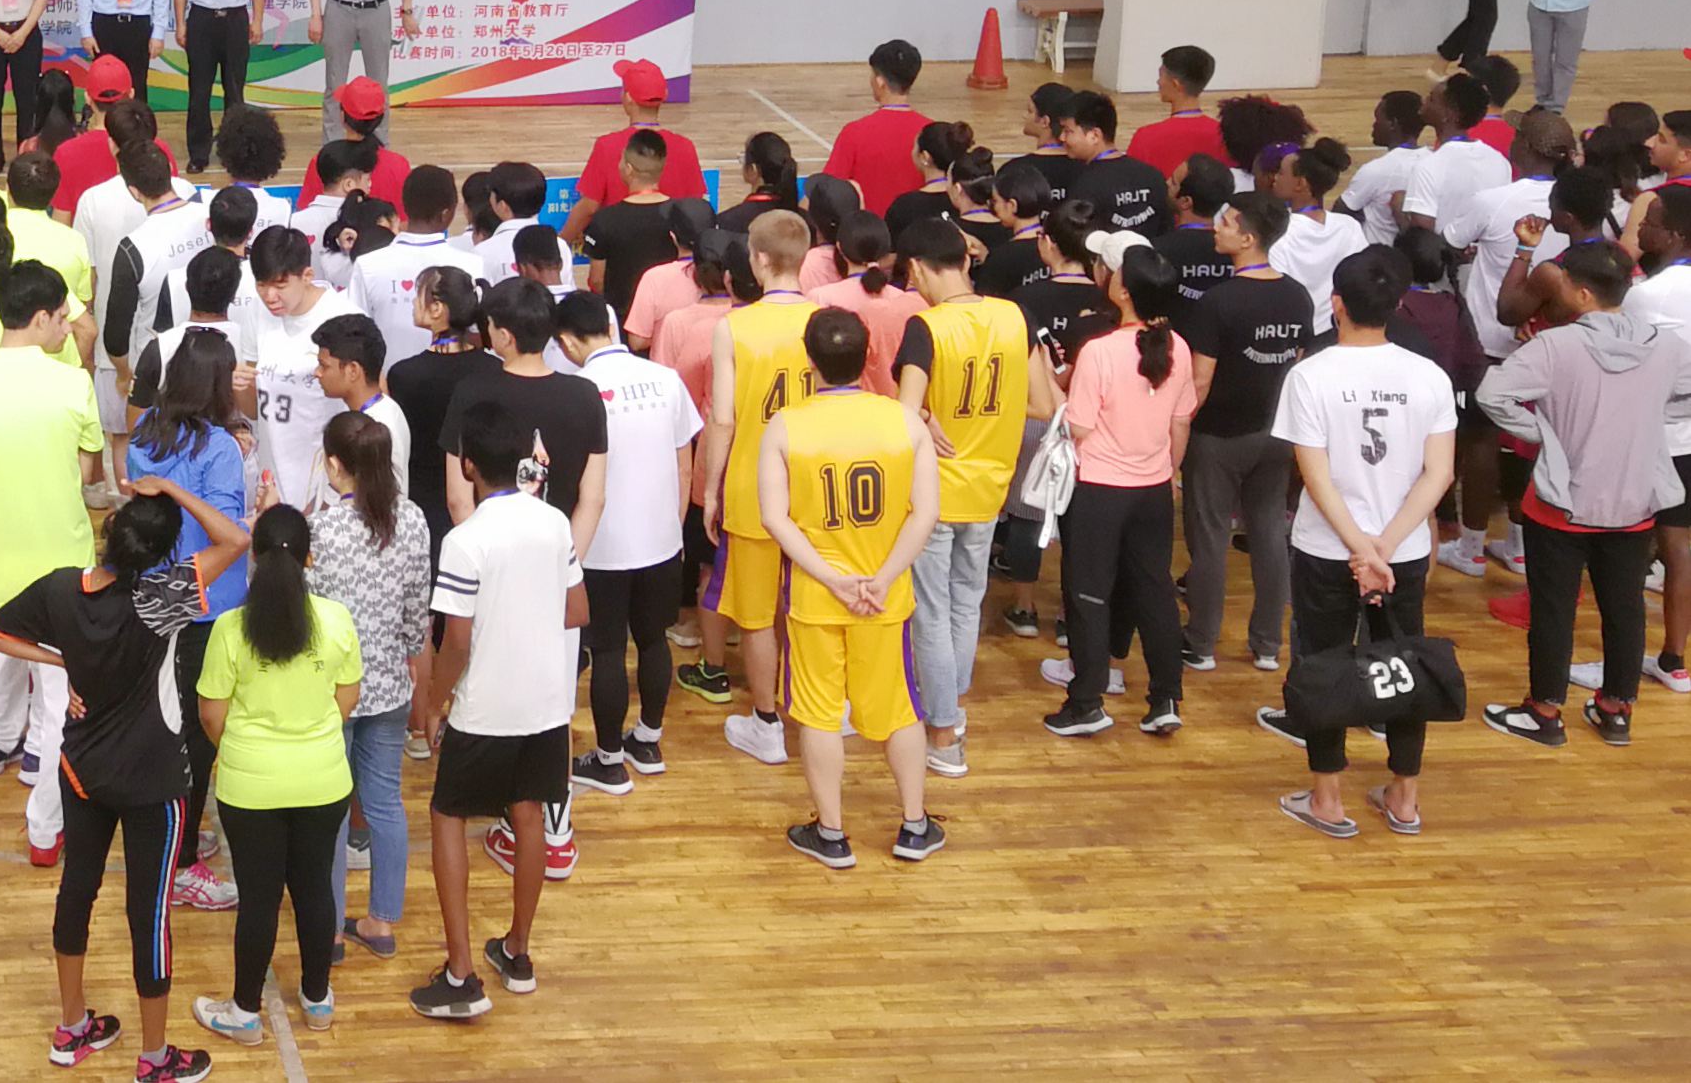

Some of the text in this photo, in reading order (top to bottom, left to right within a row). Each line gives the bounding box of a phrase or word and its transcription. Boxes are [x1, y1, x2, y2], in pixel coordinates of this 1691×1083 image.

[1255, 324, 1302, 341] HAUT
[621, 381, 664, 401] HPU
[954, 352, 1003, 418] 11
[1342, 390, 1408, 405] Li Xiang
[257, 388, 293, 424] 23
[1360, 407, 1389, 466] 5
[819, 459, 885, 531] 10
[1369, 656, 1415, 699] 23
